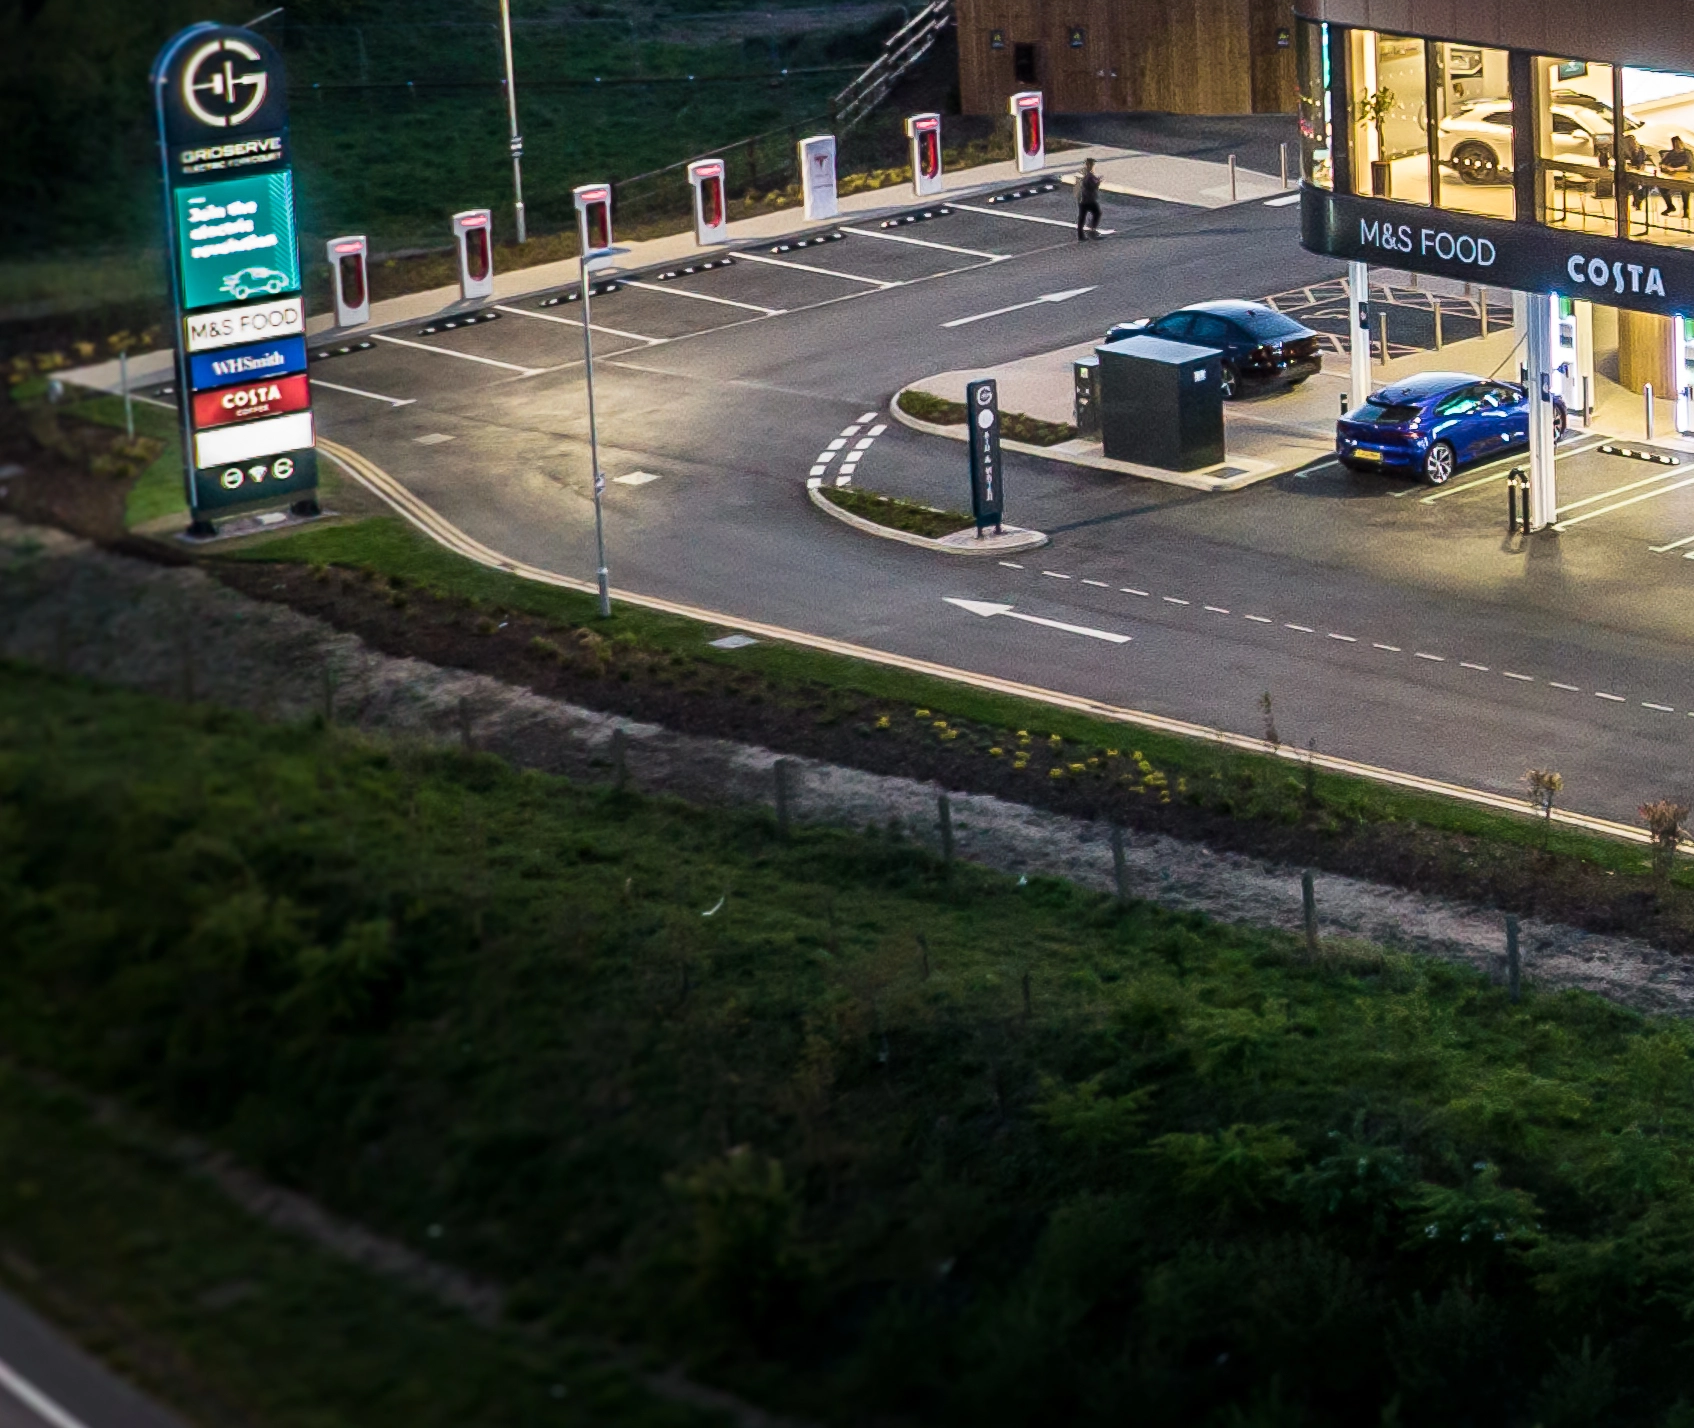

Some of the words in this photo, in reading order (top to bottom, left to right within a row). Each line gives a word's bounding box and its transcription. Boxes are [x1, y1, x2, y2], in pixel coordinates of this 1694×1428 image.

[1360, 217, 1413, 255] M&S
[1421, 229, 1497, 267] FOOD
[1567, 254, 1666, 297] COSTA
[191, 319, 234, 341] M&S
[240, 308, 298, 332] FOOD
[211, 350, 285, 376] WHSmith
[221, 384, 283, 410] COSTA
